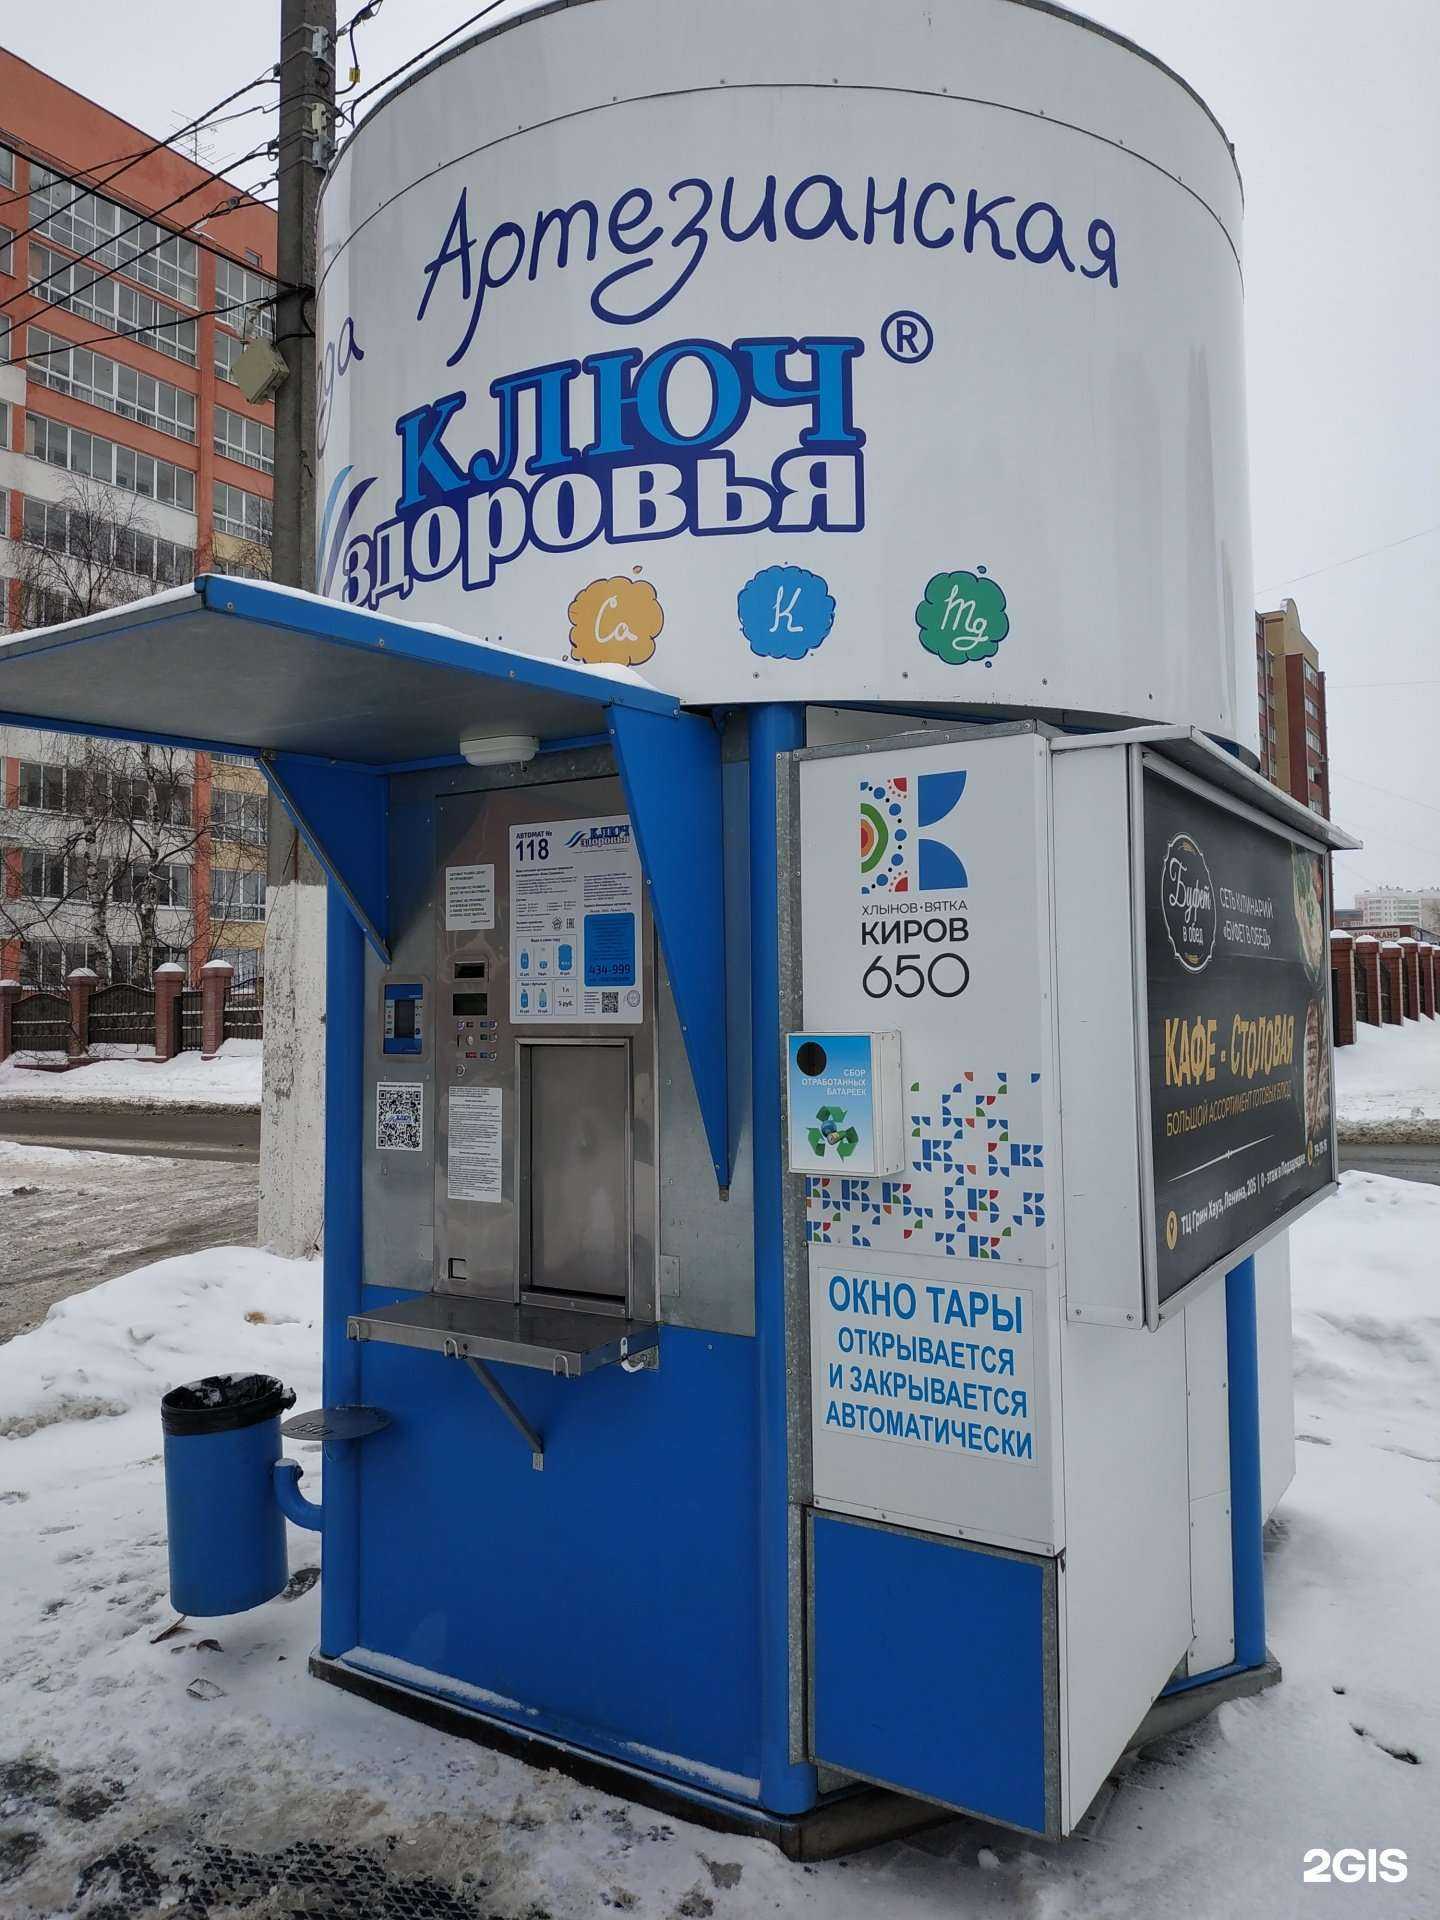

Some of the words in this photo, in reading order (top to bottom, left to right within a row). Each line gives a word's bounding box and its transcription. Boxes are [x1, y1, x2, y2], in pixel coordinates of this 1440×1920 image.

[416, 174, 1119, 367] Артезианская
[396, 337, 866, 508] КЛЮЧ
[940, 585, 989, 651] Mg
[515, 838, 550, 861] 118
[1168, 857, 1211, 924] Буфет
[1219, 887, 1236, 911] СЕТЬ
[861, 917, 970, 945] КИРОВ
[862, 952, 970, 999] 650
[843, 1068, 866, 1077] СБОР
[1164, 1015, 1217, 1088] КАФЕ
[1230, 1013, 1295, 1080] СТОЛОВАЯ
[801, 1078, 866, 1087] ОТРАБОТАННЫХ
[826, 1087, 867, 1096] БАТАРЕЕК
[1166, 1098, 1209, 1137] БОЛЬШОЙ
[1180, 1213, 1193, 1236] ТЦ
[1192, 1208, 1210, 1232] Грин
[828, 1275, 917, 1320] ОКНО
[925, 1286, 1022, 1334] ТАРЫ
[838, 1326, 1015, 1376] ОТКРЫВАЕТСЯ
[829, 1362, 843, 1390] И
[849, 1365, 1027, 1418] ЗАКРЫВАЕТСЯ
[825, 1400, 1033, 1460] АВТОМАТИЧЕСКИ
